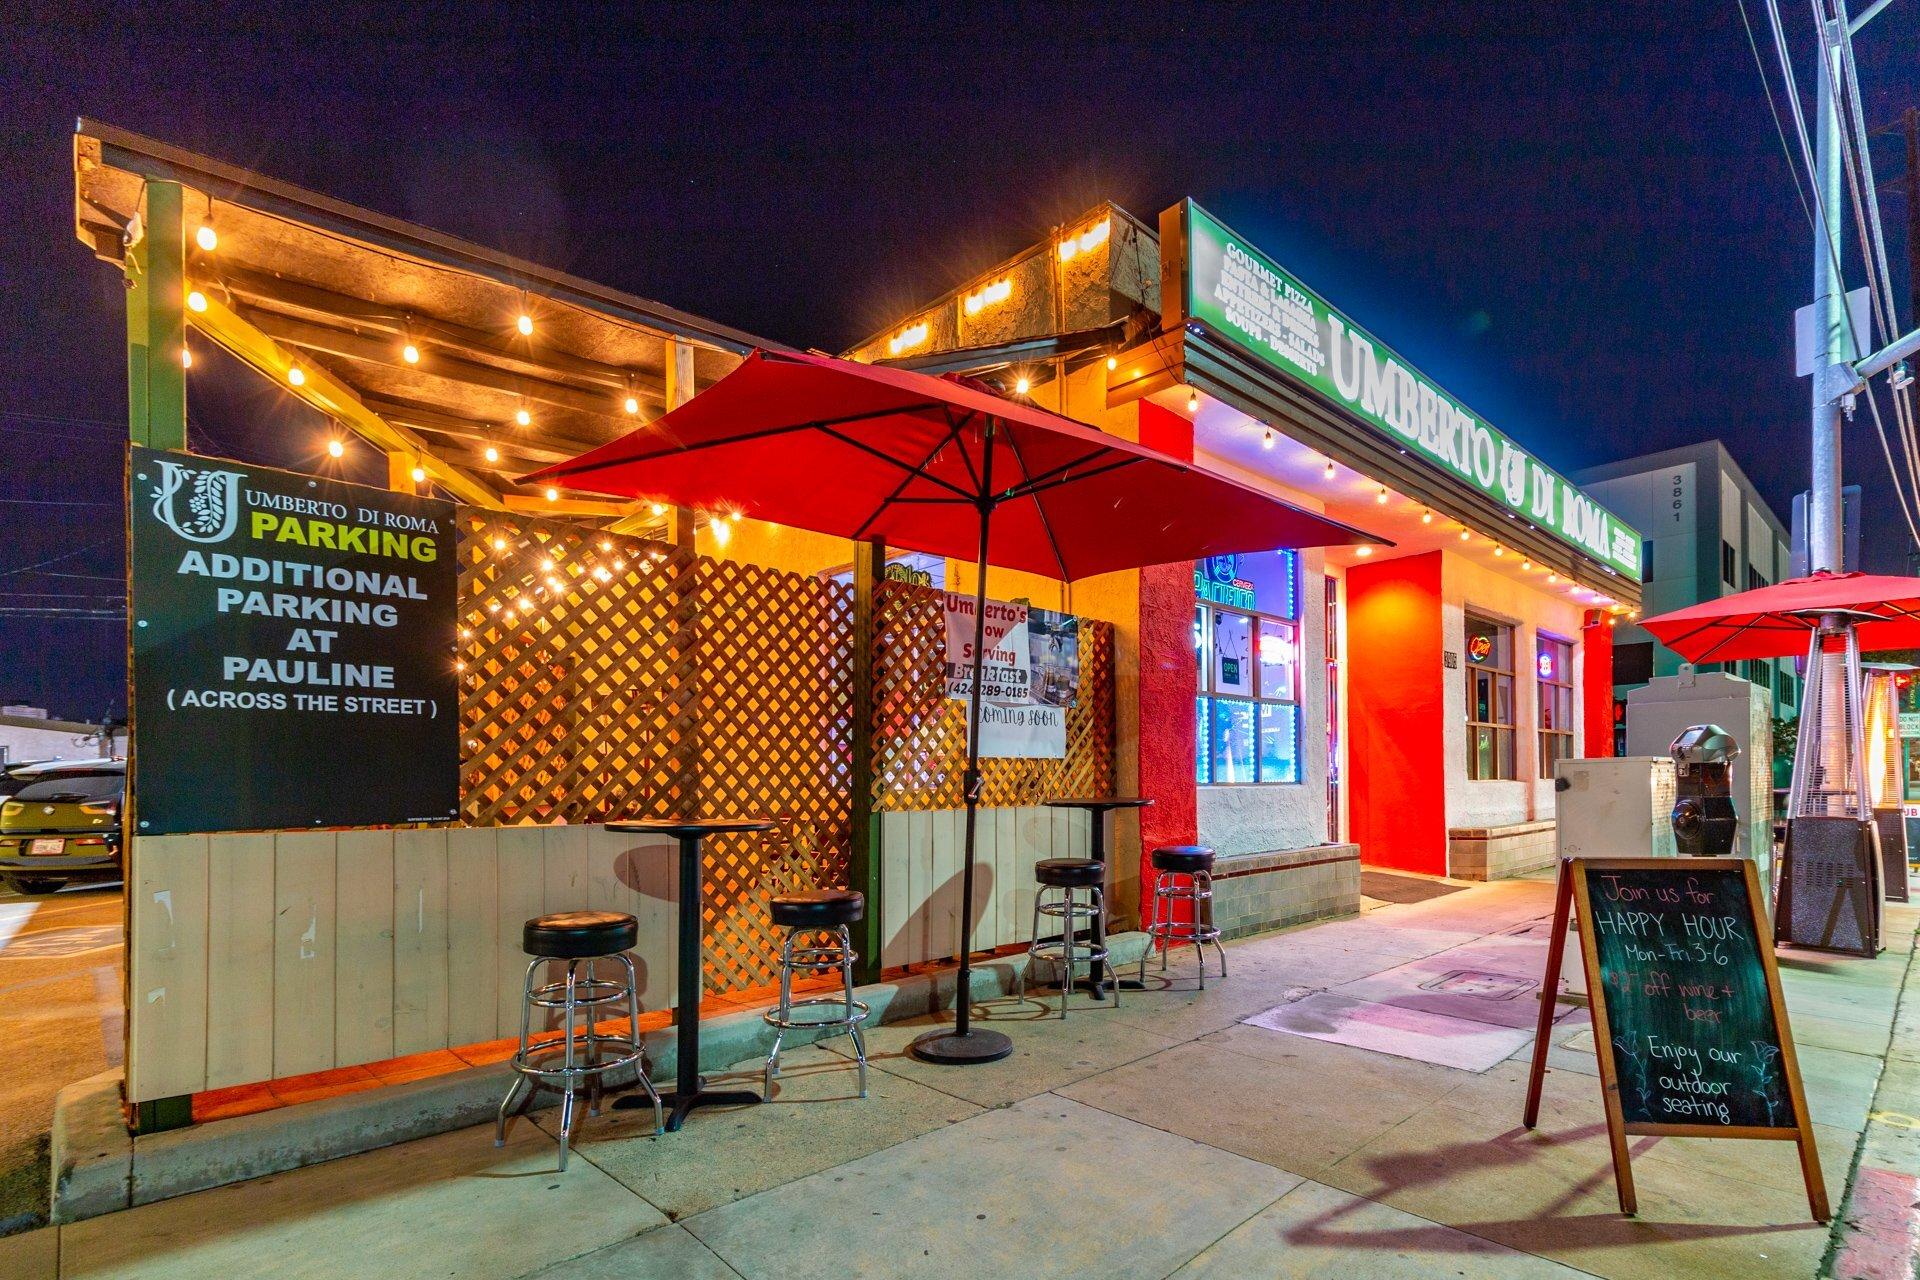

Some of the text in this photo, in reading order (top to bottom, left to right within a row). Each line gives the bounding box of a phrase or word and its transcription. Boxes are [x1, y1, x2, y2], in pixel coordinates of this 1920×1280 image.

[1223, 254, 1260, 292] PASTA
[1226, 242, 1315, 316] GOURMET PIZZA
[1225, 306, 1262, 341] SOUPS
[1288, 332, 1325, 367] SALADS
[1328, 313, 1496, 488] UMBERTO
[1532, 463, 1555, 526] DI
[1562, 484, 1611, 560] ROMA
[246, 489, 440, 535] UMBERTO DI ROMA
[1672, 475, 1682, 522] 3861
[251, 511, 437, 563] PARKING
[177, 550, 428, 601] ADDITIONAL
[217, 587, 399, 628] PARKING
[946, 594, 1027, 624] Umerto's
[286, 628, 339, 654] AT
[984, 625, 1005, 638] ow
[963, 643, 1016, 667] Srving
[223, 656, 396, 689] PAULINE
[181, 689, 288, 711] ACROSS
[292, 694, 340, 712] THE
[344, 696, 426, 715] STREET
[1027, 709, 1059, 727] soon
[1601, 875, 1715, 904] Join us for
[1595, 911, 1744, 941] HAPPY HOUR
[1682, 1002, 1723, 1024] beer
[1647, 1035, 1742, 1076] Enjoy our
[1659, 1068, 1732, 1096] outdoor
[1662, 1095, 1731, 1125] seating
